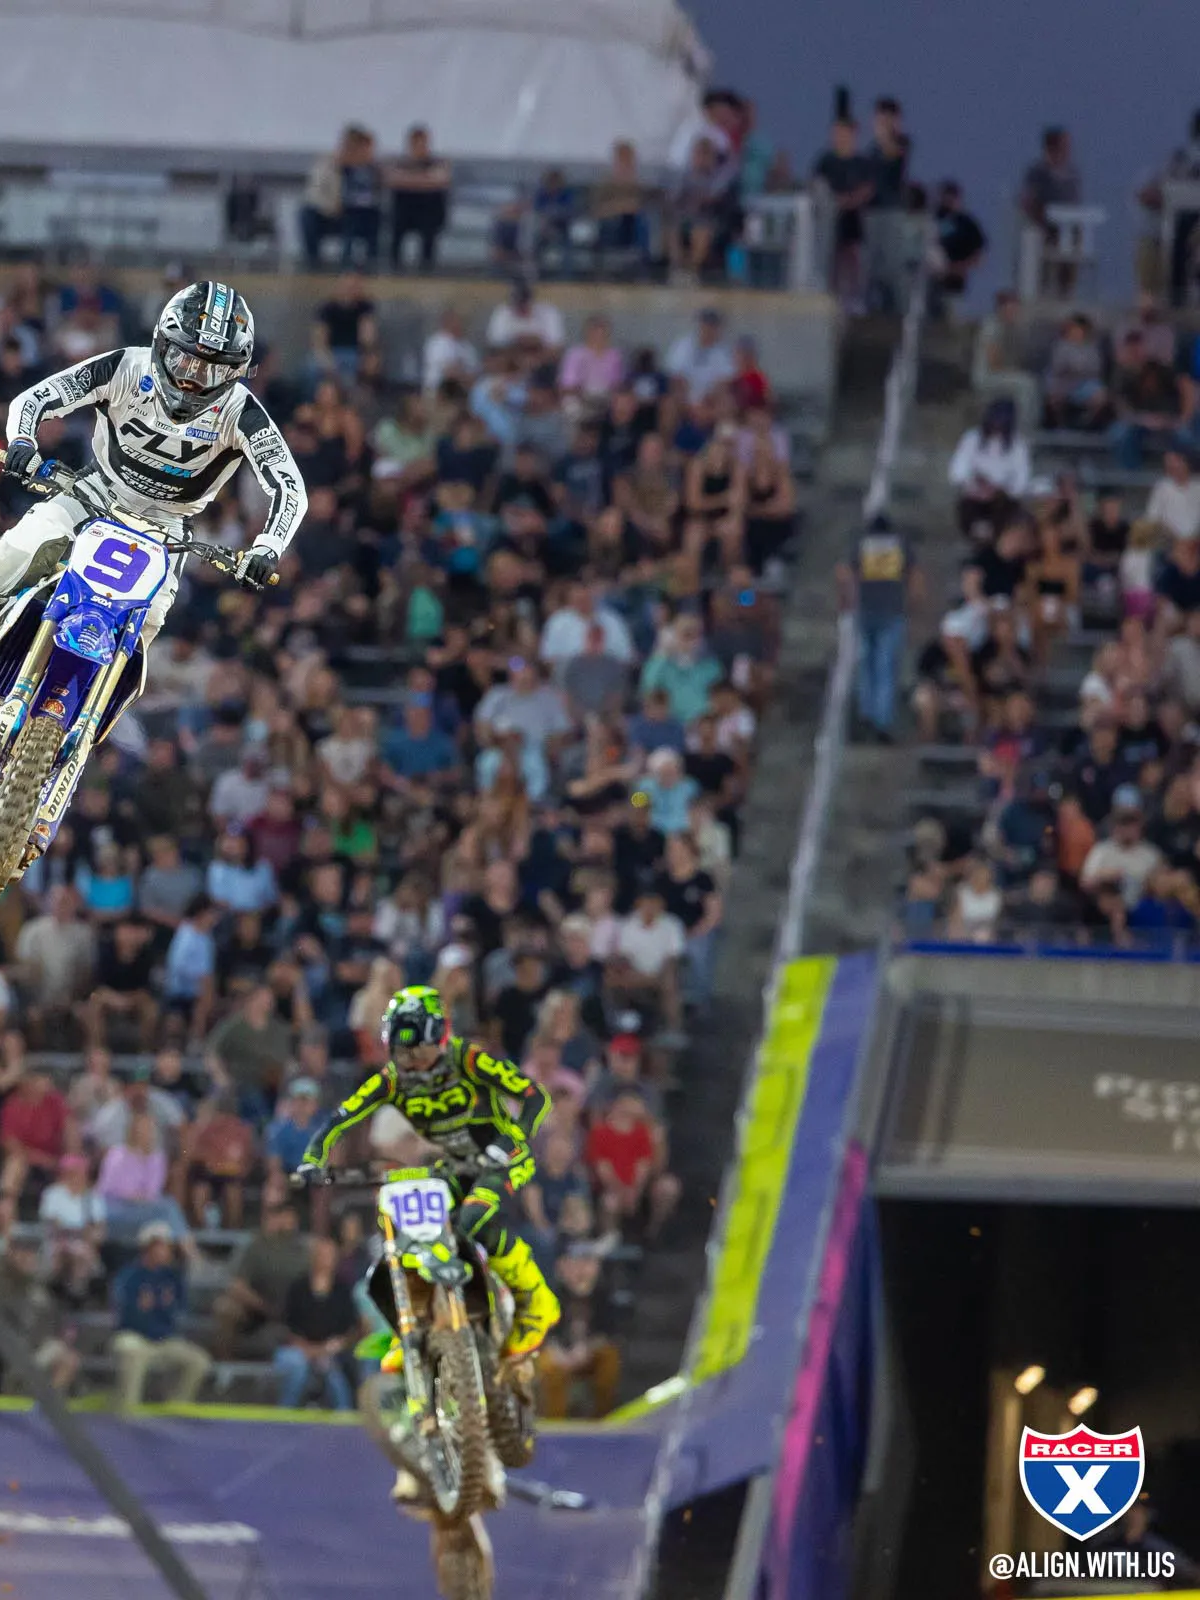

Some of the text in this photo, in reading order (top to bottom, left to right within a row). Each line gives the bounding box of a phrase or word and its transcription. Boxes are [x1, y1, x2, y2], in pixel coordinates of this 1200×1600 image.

[210, 290, 227, 333] CLUBMX
[120, 417, 213, 464] FLY
[253, 436, 279, 451] YAMALUBE
[29, 482, 53, 493] ASV
[120, 465, 184, 492] PAULSON
[83, 537, 151, 593] 9
[48, 754, 80, 818] DUNLOP
[390, 1190, 445, 1230] 199
